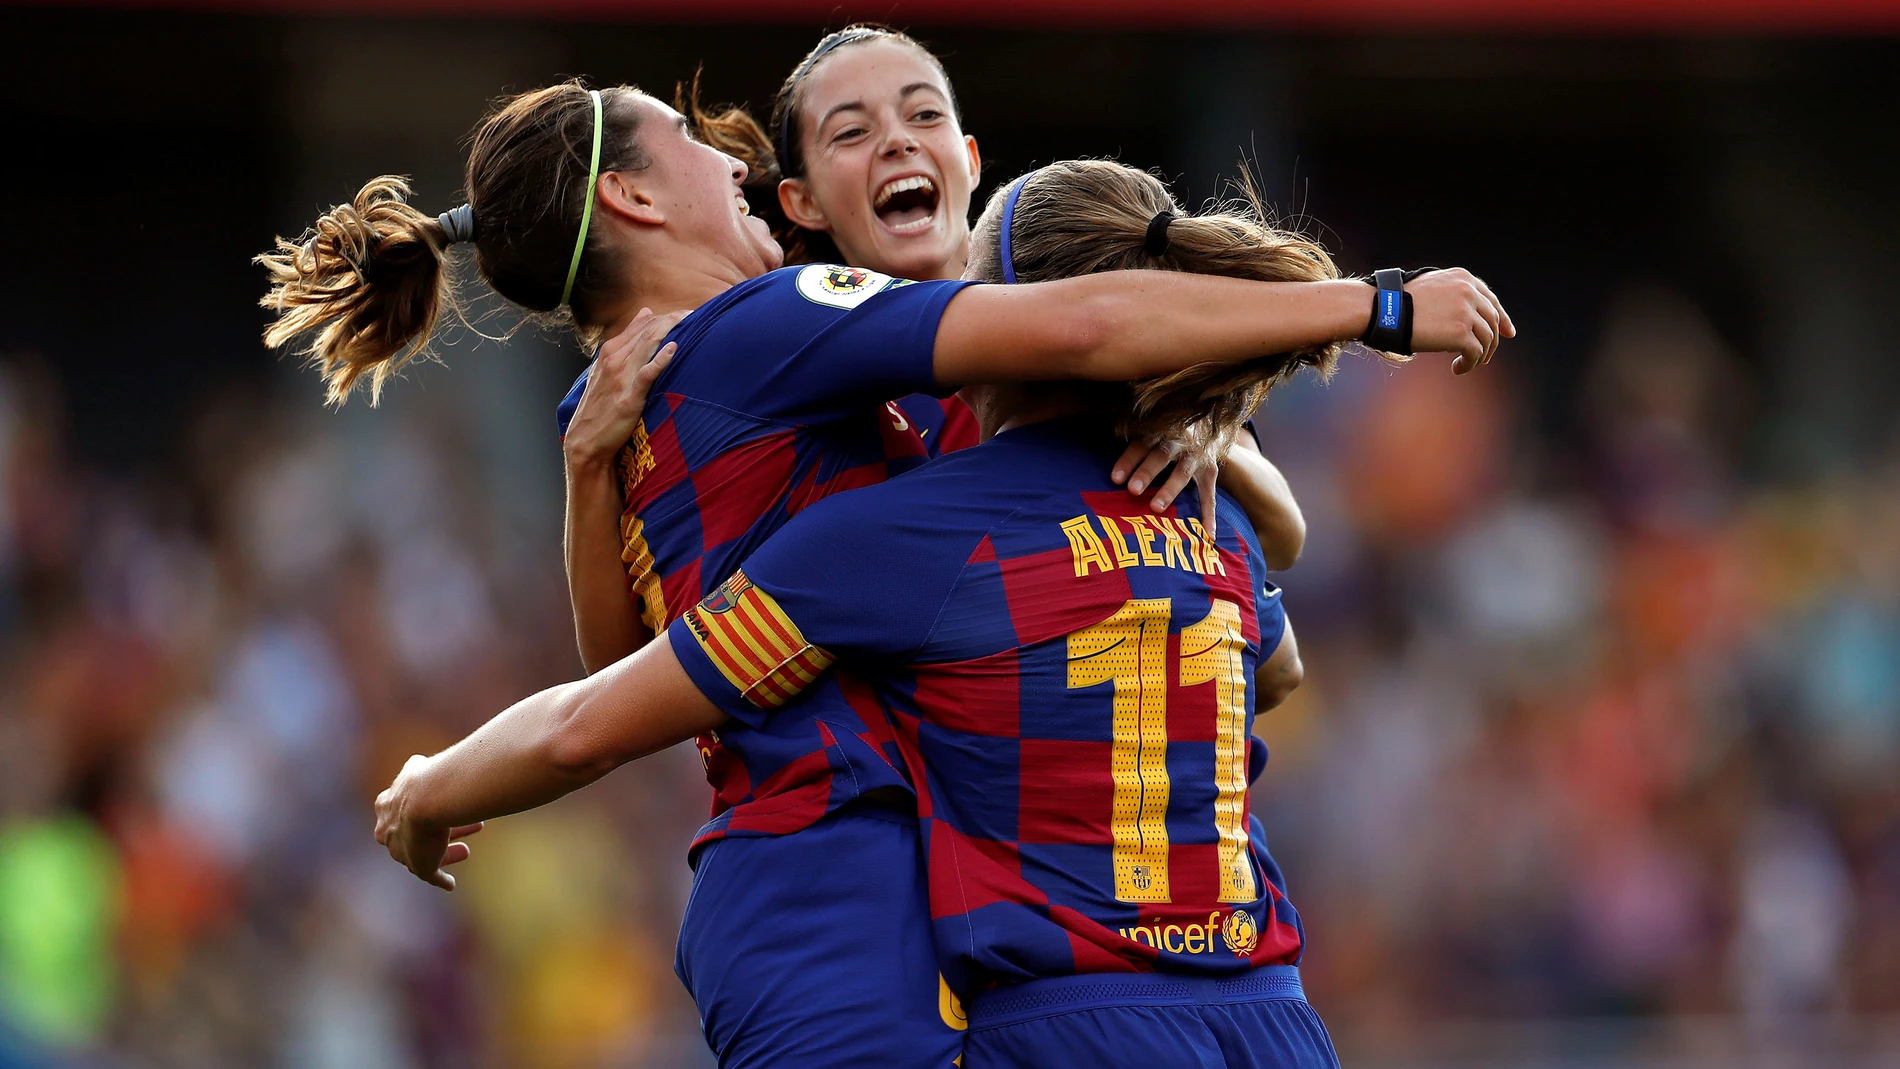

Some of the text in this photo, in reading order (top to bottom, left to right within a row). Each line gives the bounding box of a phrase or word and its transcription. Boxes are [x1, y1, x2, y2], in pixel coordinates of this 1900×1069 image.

[1059, 514, 1227, 578] ALEXIA
[1067, 597, 1258, 904] 11
[1119, 911, 1220, 954] nicef
